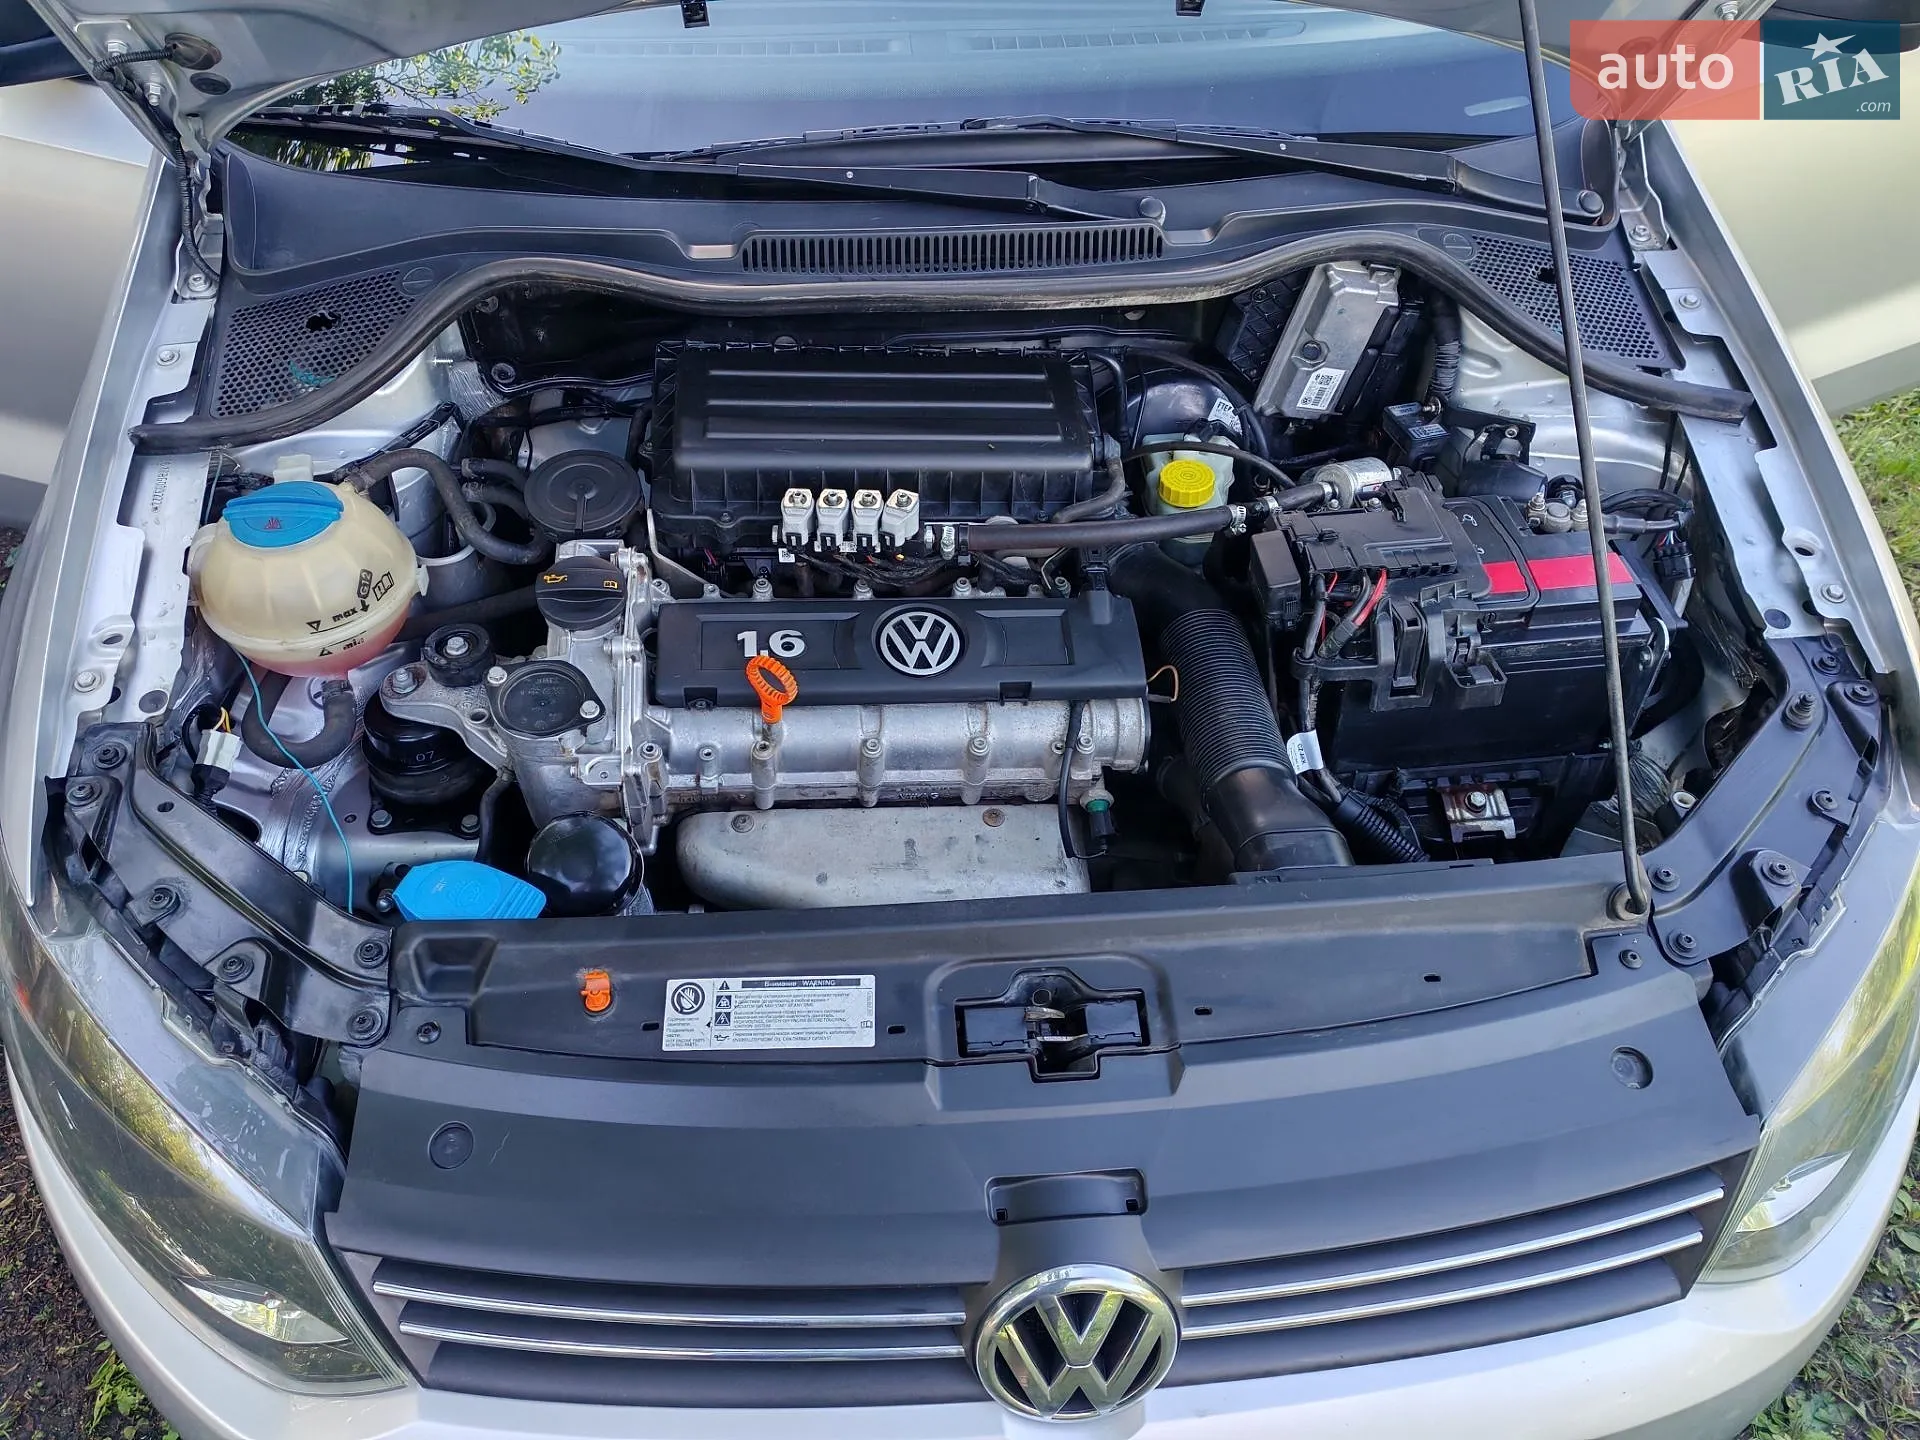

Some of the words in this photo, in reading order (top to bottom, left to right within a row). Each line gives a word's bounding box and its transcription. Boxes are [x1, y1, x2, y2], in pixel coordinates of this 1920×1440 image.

[332, 607, 358, 622] max
[737, 629, 805, 658] 1.6
[802, 979, 836, 987] WARNING
